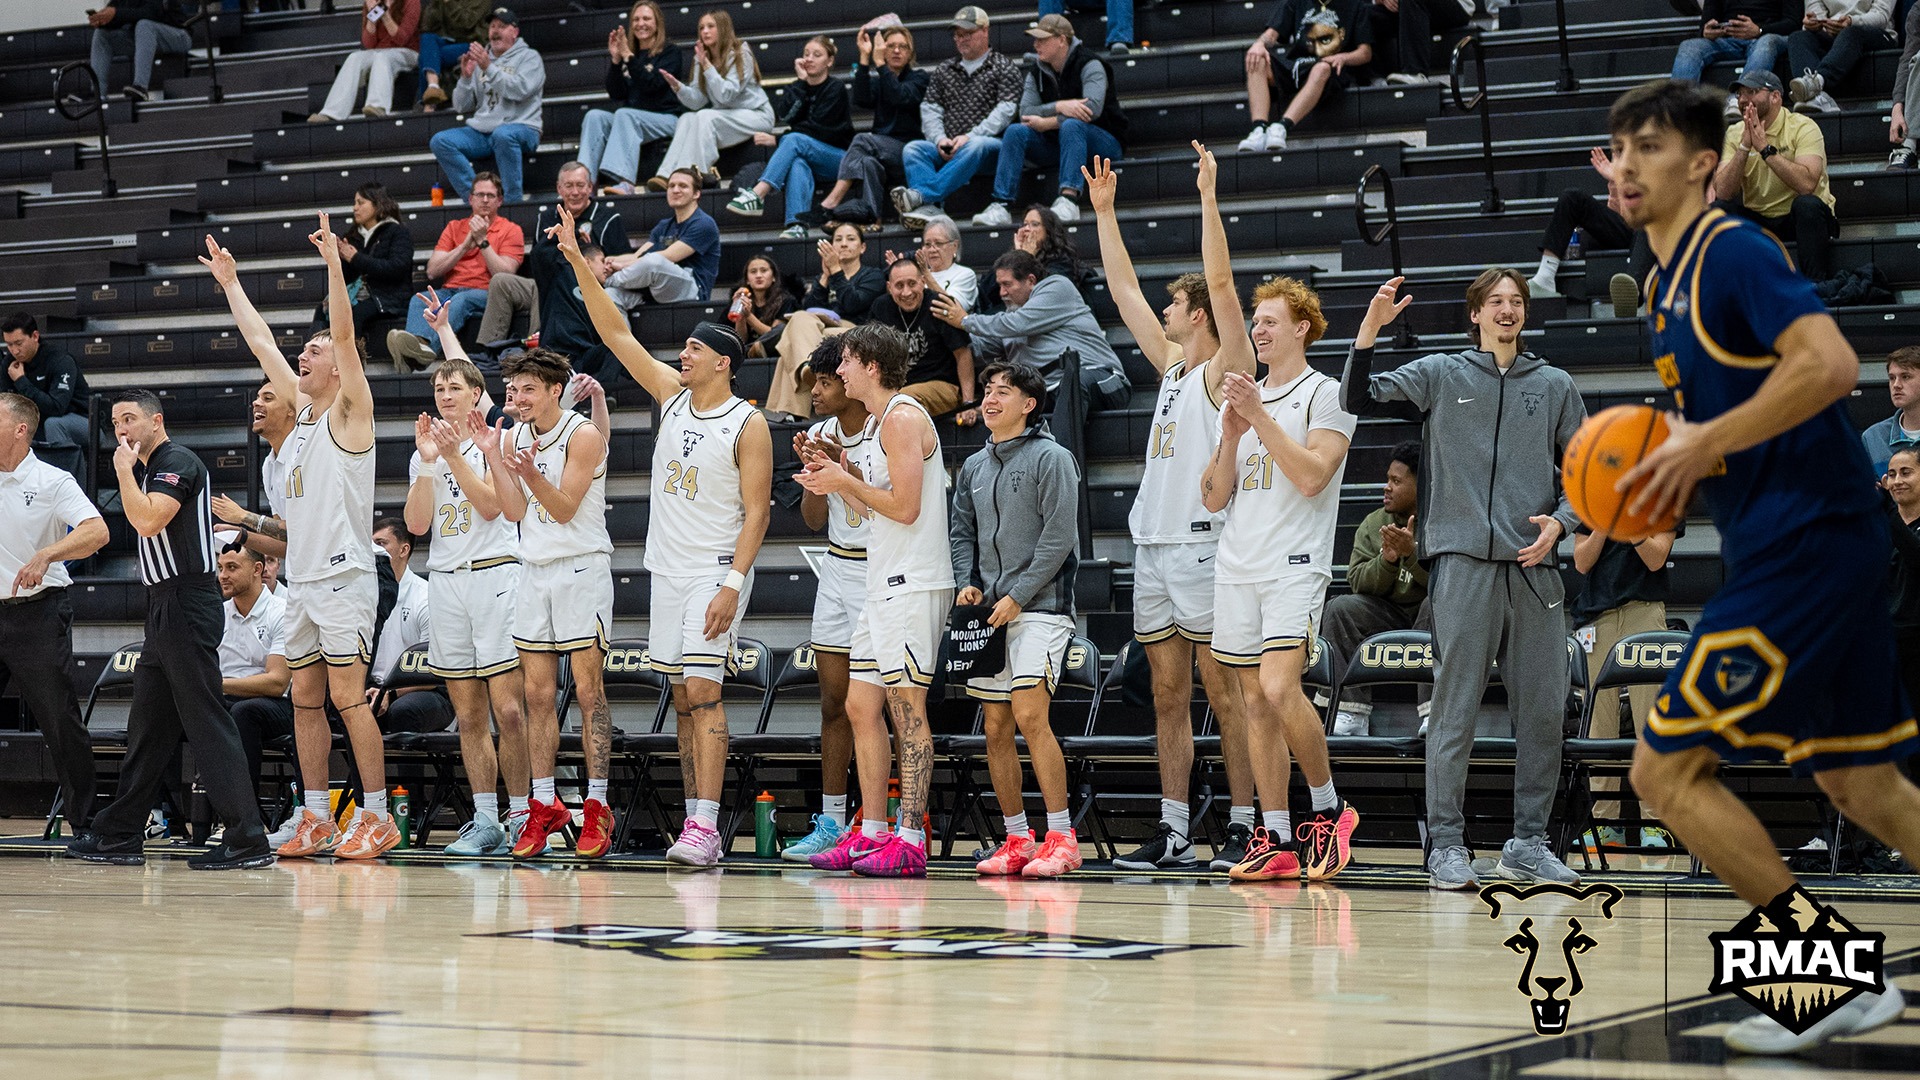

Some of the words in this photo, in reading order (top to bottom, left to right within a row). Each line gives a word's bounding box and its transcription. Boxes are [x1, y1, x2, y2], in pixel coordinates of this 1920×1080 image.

[663, 459, 699, 501] 24
[1243, 453, 1274, 491] 21
[438, 500, 473, 538] 23
[967, 619, 980, 630] GO
[1615, 642, 1684, 669] UCC
